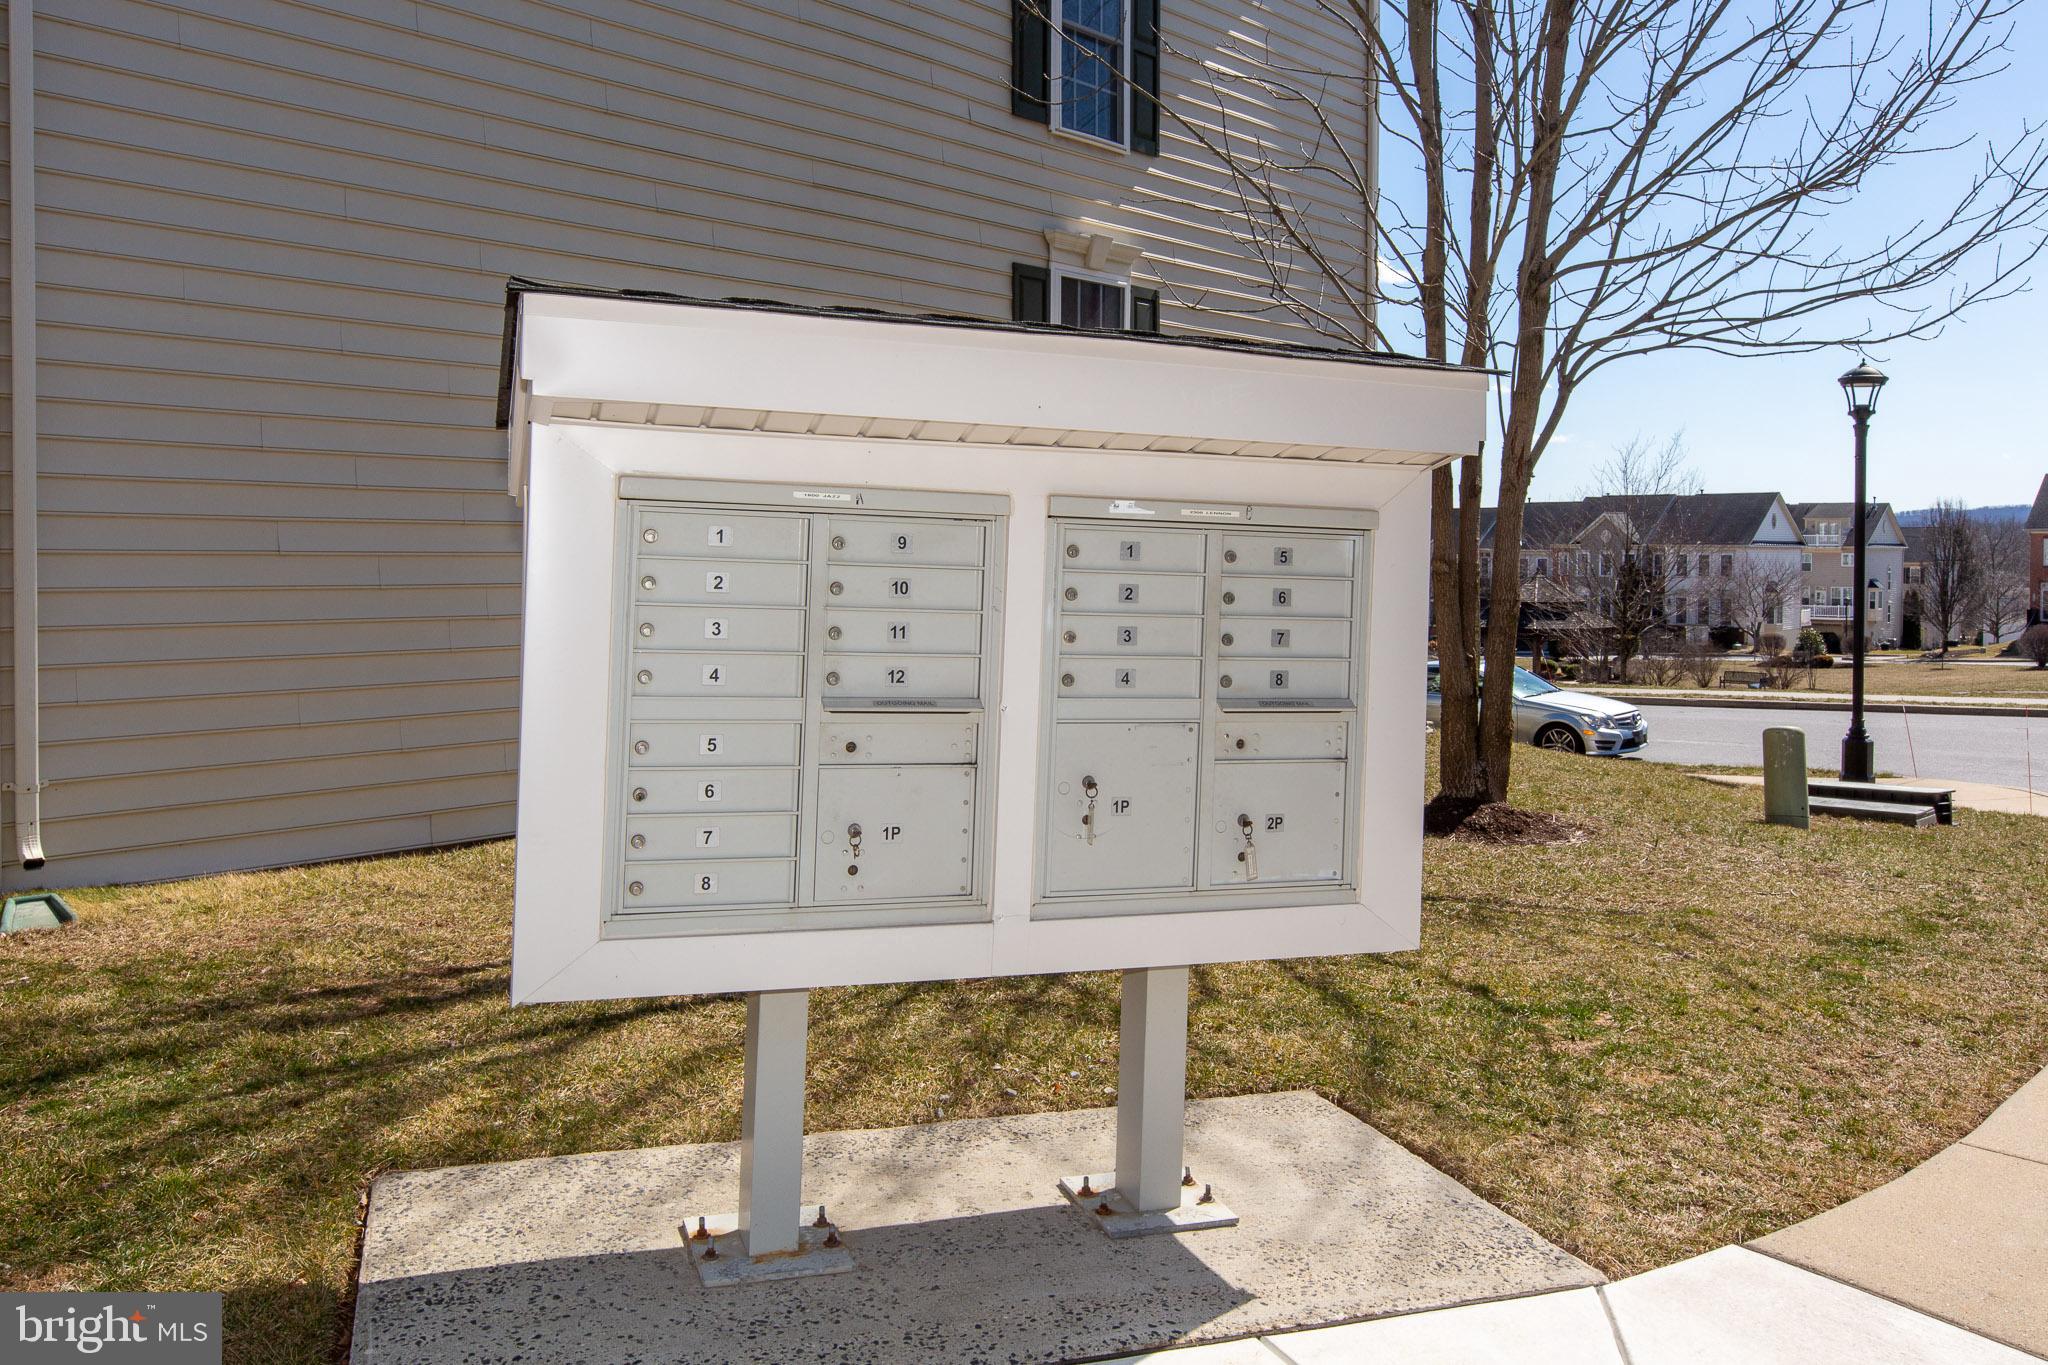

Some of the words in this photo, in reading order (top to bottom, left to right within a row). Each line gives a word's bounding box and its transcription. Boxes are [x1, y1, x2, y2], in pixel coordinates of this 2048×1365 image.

[716, 530, 724, 543] 1
[898, 536, 906, 549] 9
[1126, 545, 1133, 557] 1
[1279, 551, 1288, 563] 5
[714, 576, 723, 589] 2
[892, 581, 908, 594] 10
[1124, 588, 1133, 600] 2
[1278, 592, 1287, 604] 6
[712, 622, 721, 635] 3
[891, 626, 905, 639] 11
[1123, 630, 1132, 642] 3
[1276, 633, 1285, 644] 7
[710, 668, 719, 682] 4
[888, 670, 904, 683] 12
[1120, 672, 1130, 684] 4
[1275, 674, 1283, 686] 8
[708, 738, 716, 751] 5
[705, 784, 714, 798] 6
[1113, 800, 1130, 813] 1P
[1267, 817, 1284, 830] 2P
[704, 831, 712, 844] 7
[883, 827, 900, 840] 1P
[702, 877, 710, 890] 8
